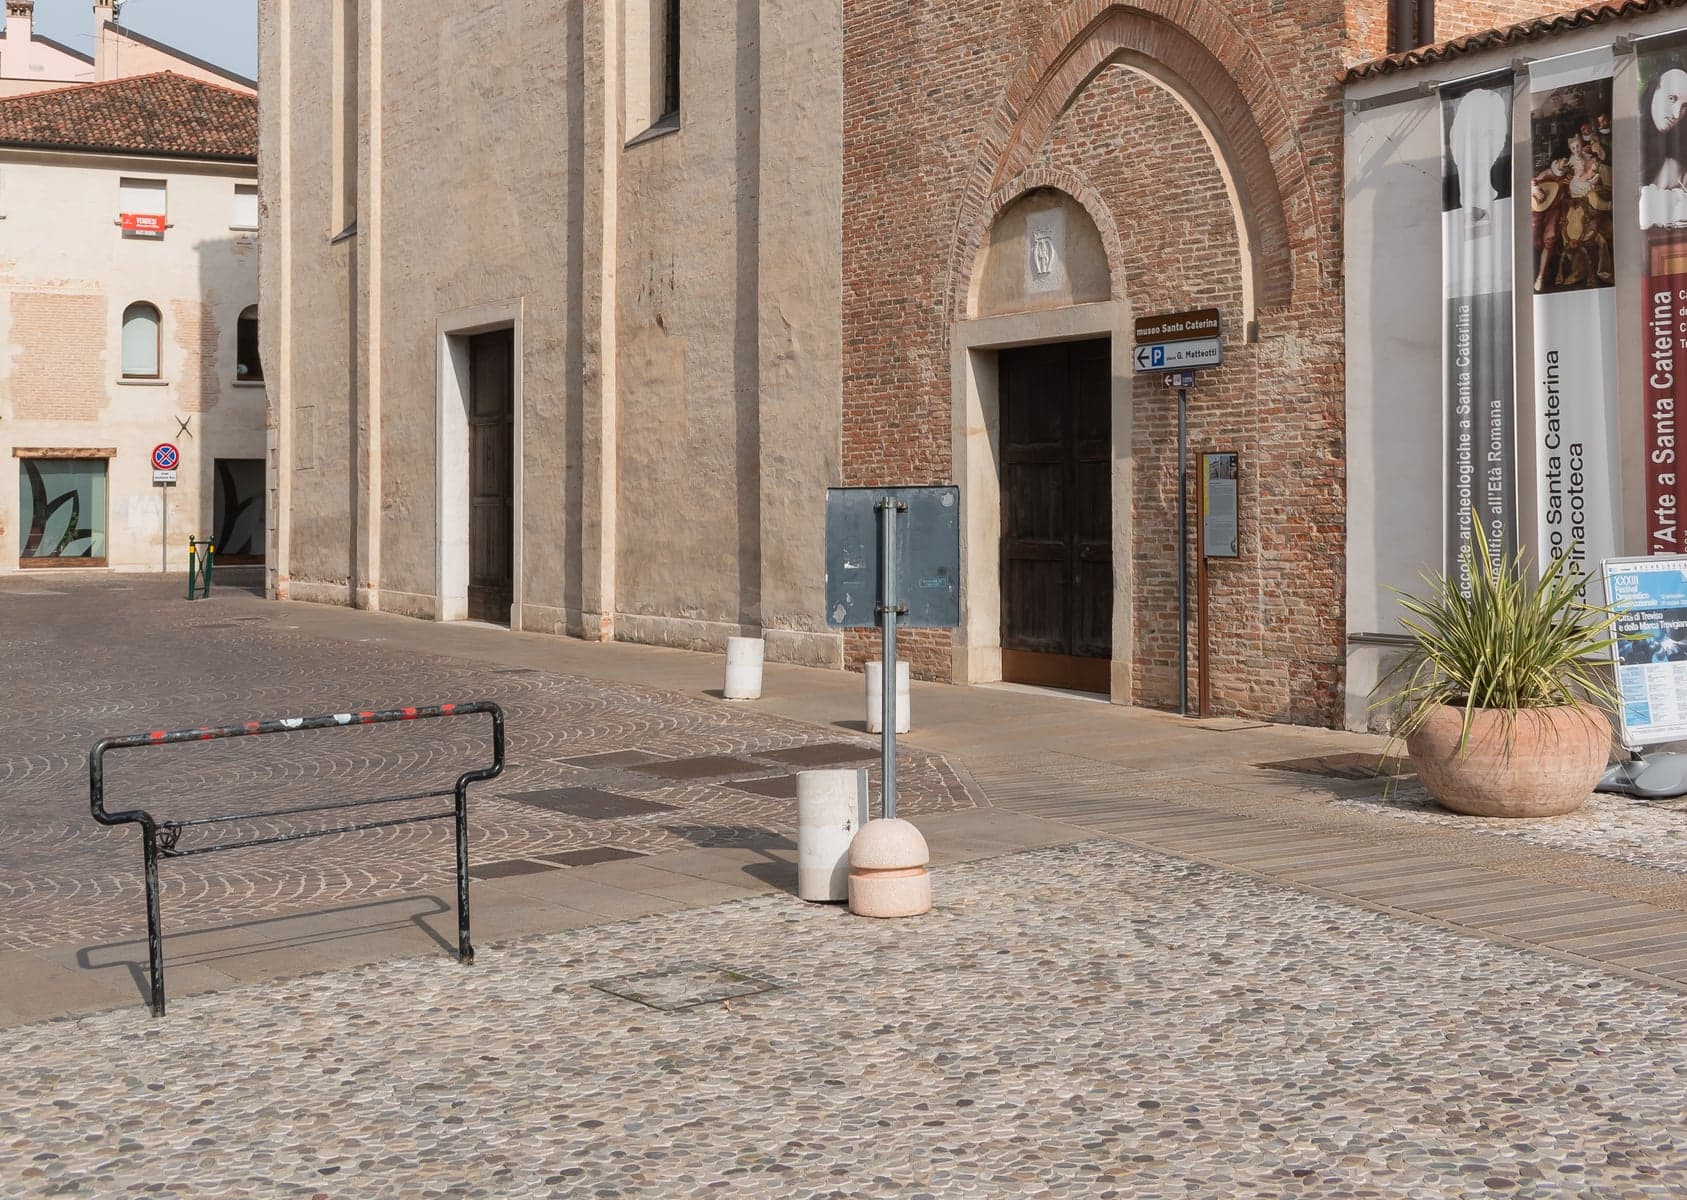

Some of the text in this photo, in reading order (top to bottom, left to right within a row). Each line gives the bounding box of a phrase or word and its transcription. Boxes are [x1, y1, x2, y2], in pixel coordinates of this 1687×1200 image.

[1137, 319, 1218, 336] museo Santa Caterina
[1456, 304, 1470, 368] Caterina
[1649, 290, 1674, 389] Caterina
[1153, 349, 1162, 364] P
[1176, 352, 1184, 360] G.
[1186, 348, 1217, 359] Matteotti
[1456, 372, 1471, 415] Santa
[1543, 350, 1560, 450] Caterina
[1459, 419, 1471, 429] a
[1488, 399, 1502, 462] Romana
[1651, 397, 1676, 464] Santa
[1456, 433, 1474, 540] archeologiche
[1487, 466, 1503, 515] all'Età
[1546, 456, 1563, 525] Santa
[1658, 472, 1676, 486] a
[1567, 442, 1585, 576] Pinacoteca
[1624, 622, 1638, 631] della
[1640, 621, 1659, 630] Marca
[1634, 612, 1641, 621] di
[1642, 612, 1664, 621] Treviso
